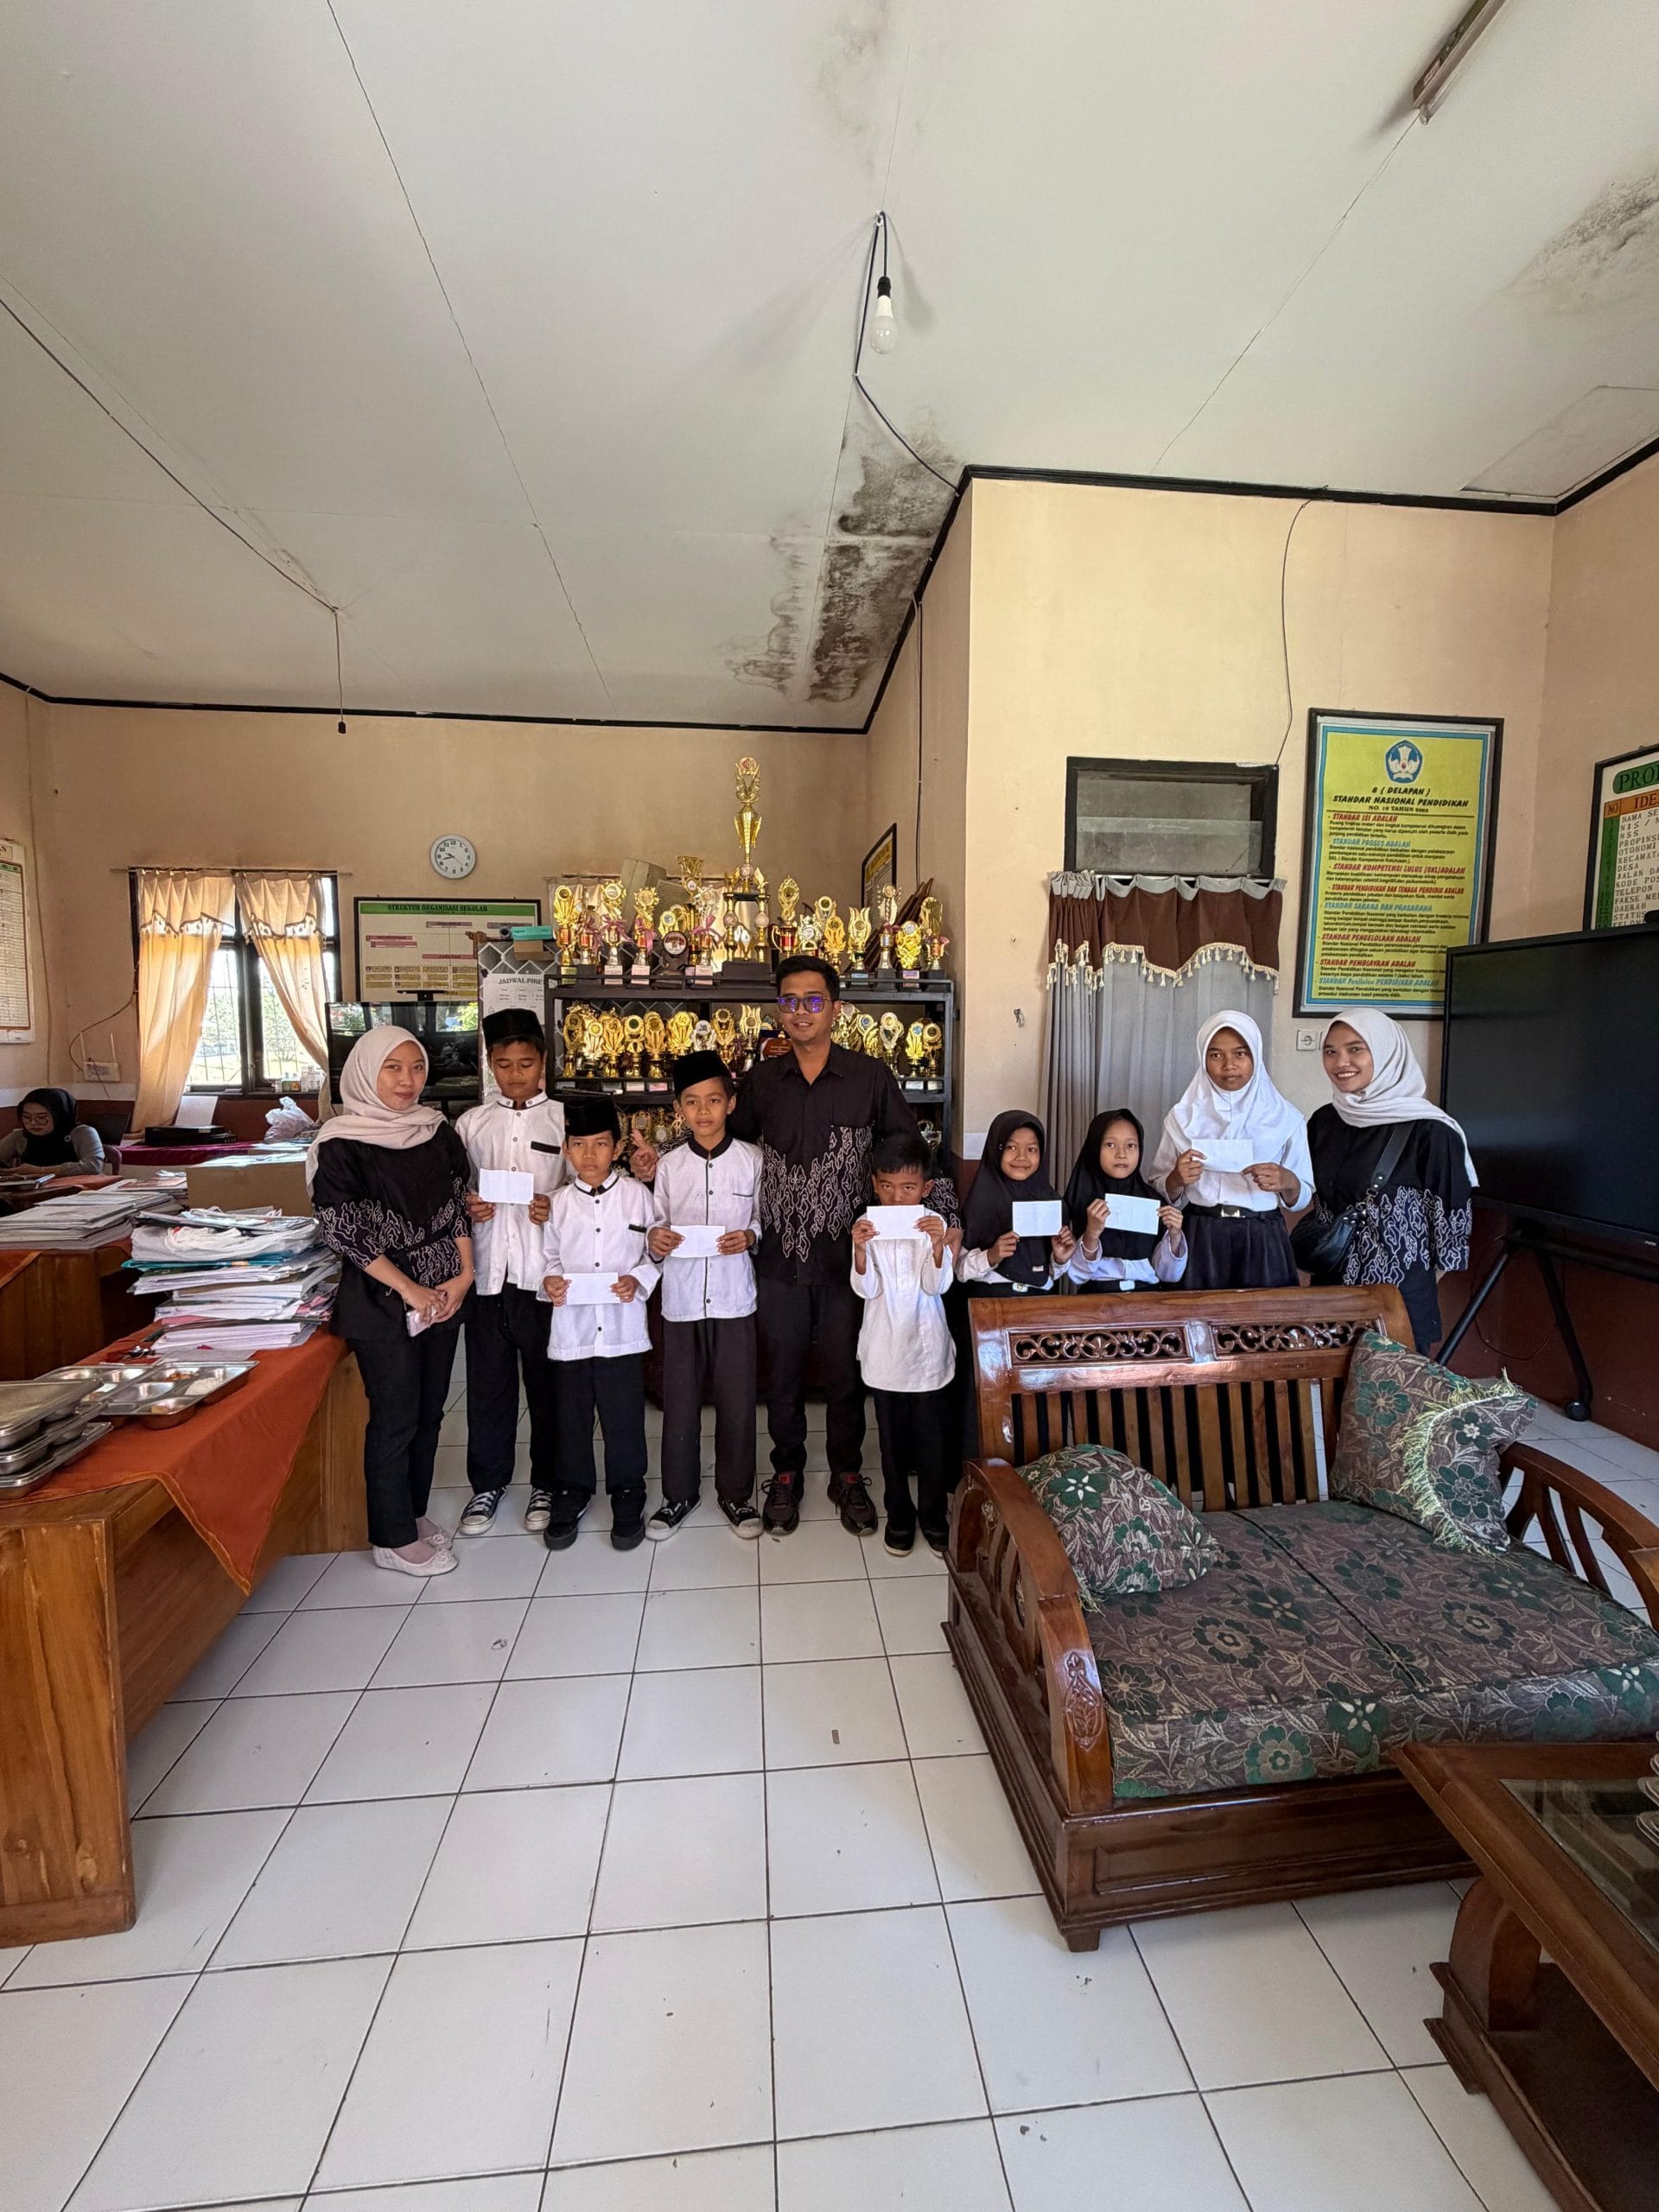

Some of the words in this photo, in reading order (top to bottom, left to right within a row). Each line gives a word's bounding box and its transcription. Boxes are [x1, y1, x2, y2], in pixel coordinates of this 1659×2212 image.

[1619, 765, 1659, 791] PRO
[1374, 797, 1415, 805] NASIONAL
[1417, 798, 1469, 807] PENDIDIKAN
[1634, 792, 1659, 809] IDE
[1623, 813, 1642, 823] NAMA
[1620, 830, 1639, 839] NSS
[1618, 842, 1656, 855] OTONOMI
[1618, 863, 1639, 872] DESA
[1616, 879, 1638, 888] KODE
[1616, 885, 1653, 896] TELEPON
